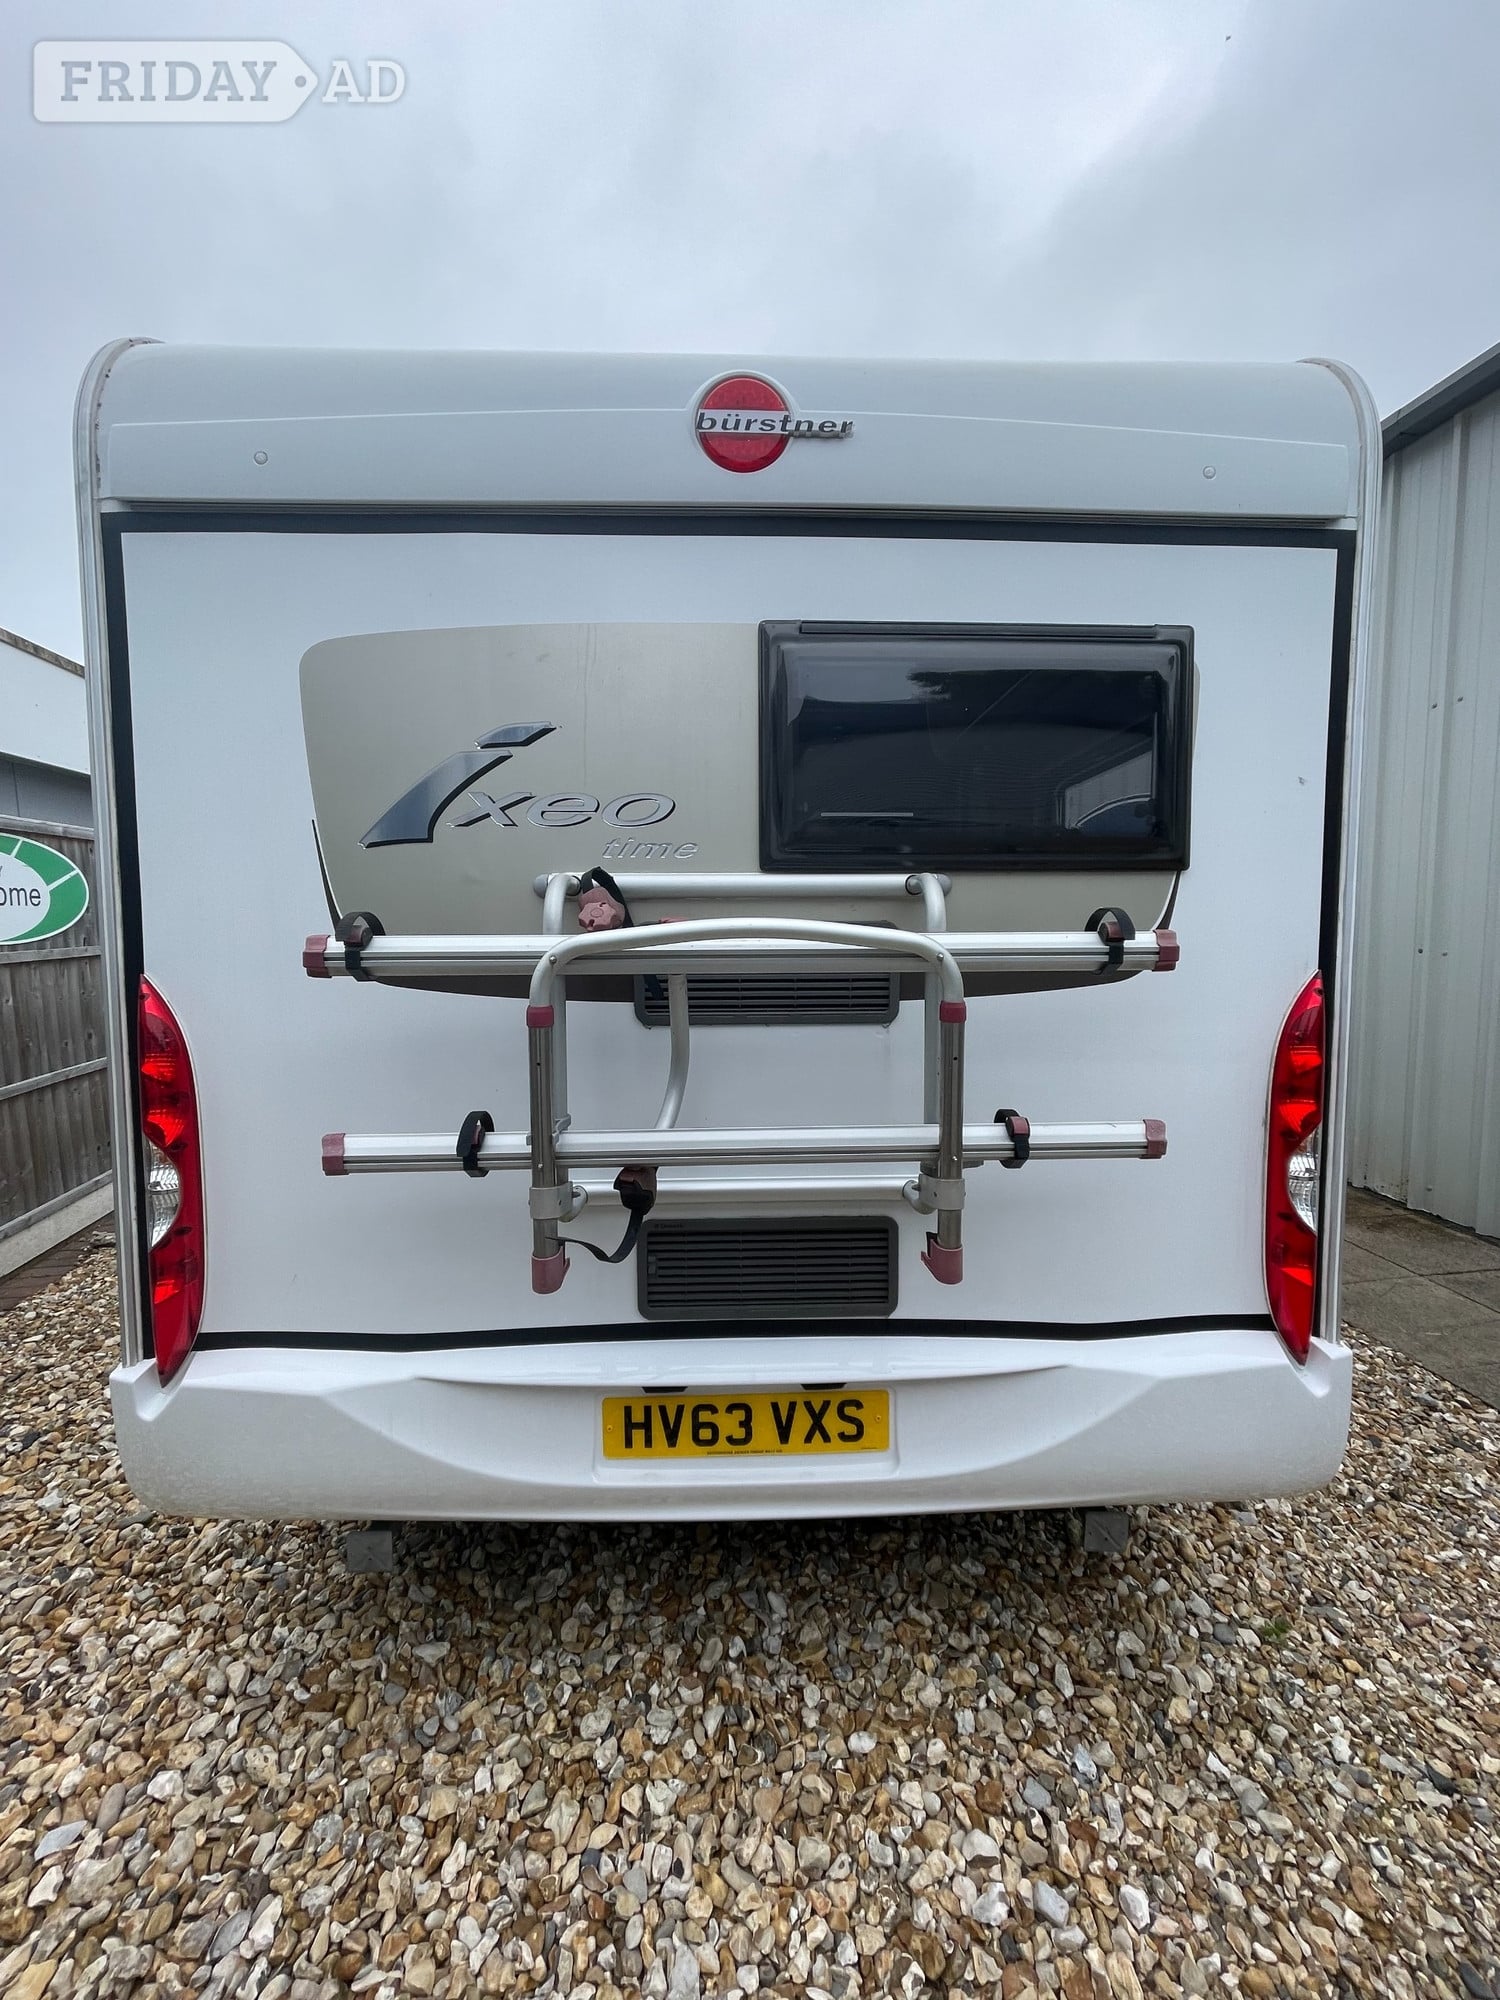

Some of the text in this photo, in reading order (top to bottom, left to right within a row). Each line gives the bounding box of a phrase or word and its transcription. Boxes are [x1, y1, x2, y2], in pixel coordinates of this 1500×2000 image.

[696, 411, 854, 434] bürstner
[602, 837, 700, 860] time
[623, 1399, 865, 1449] HV63 VXS
